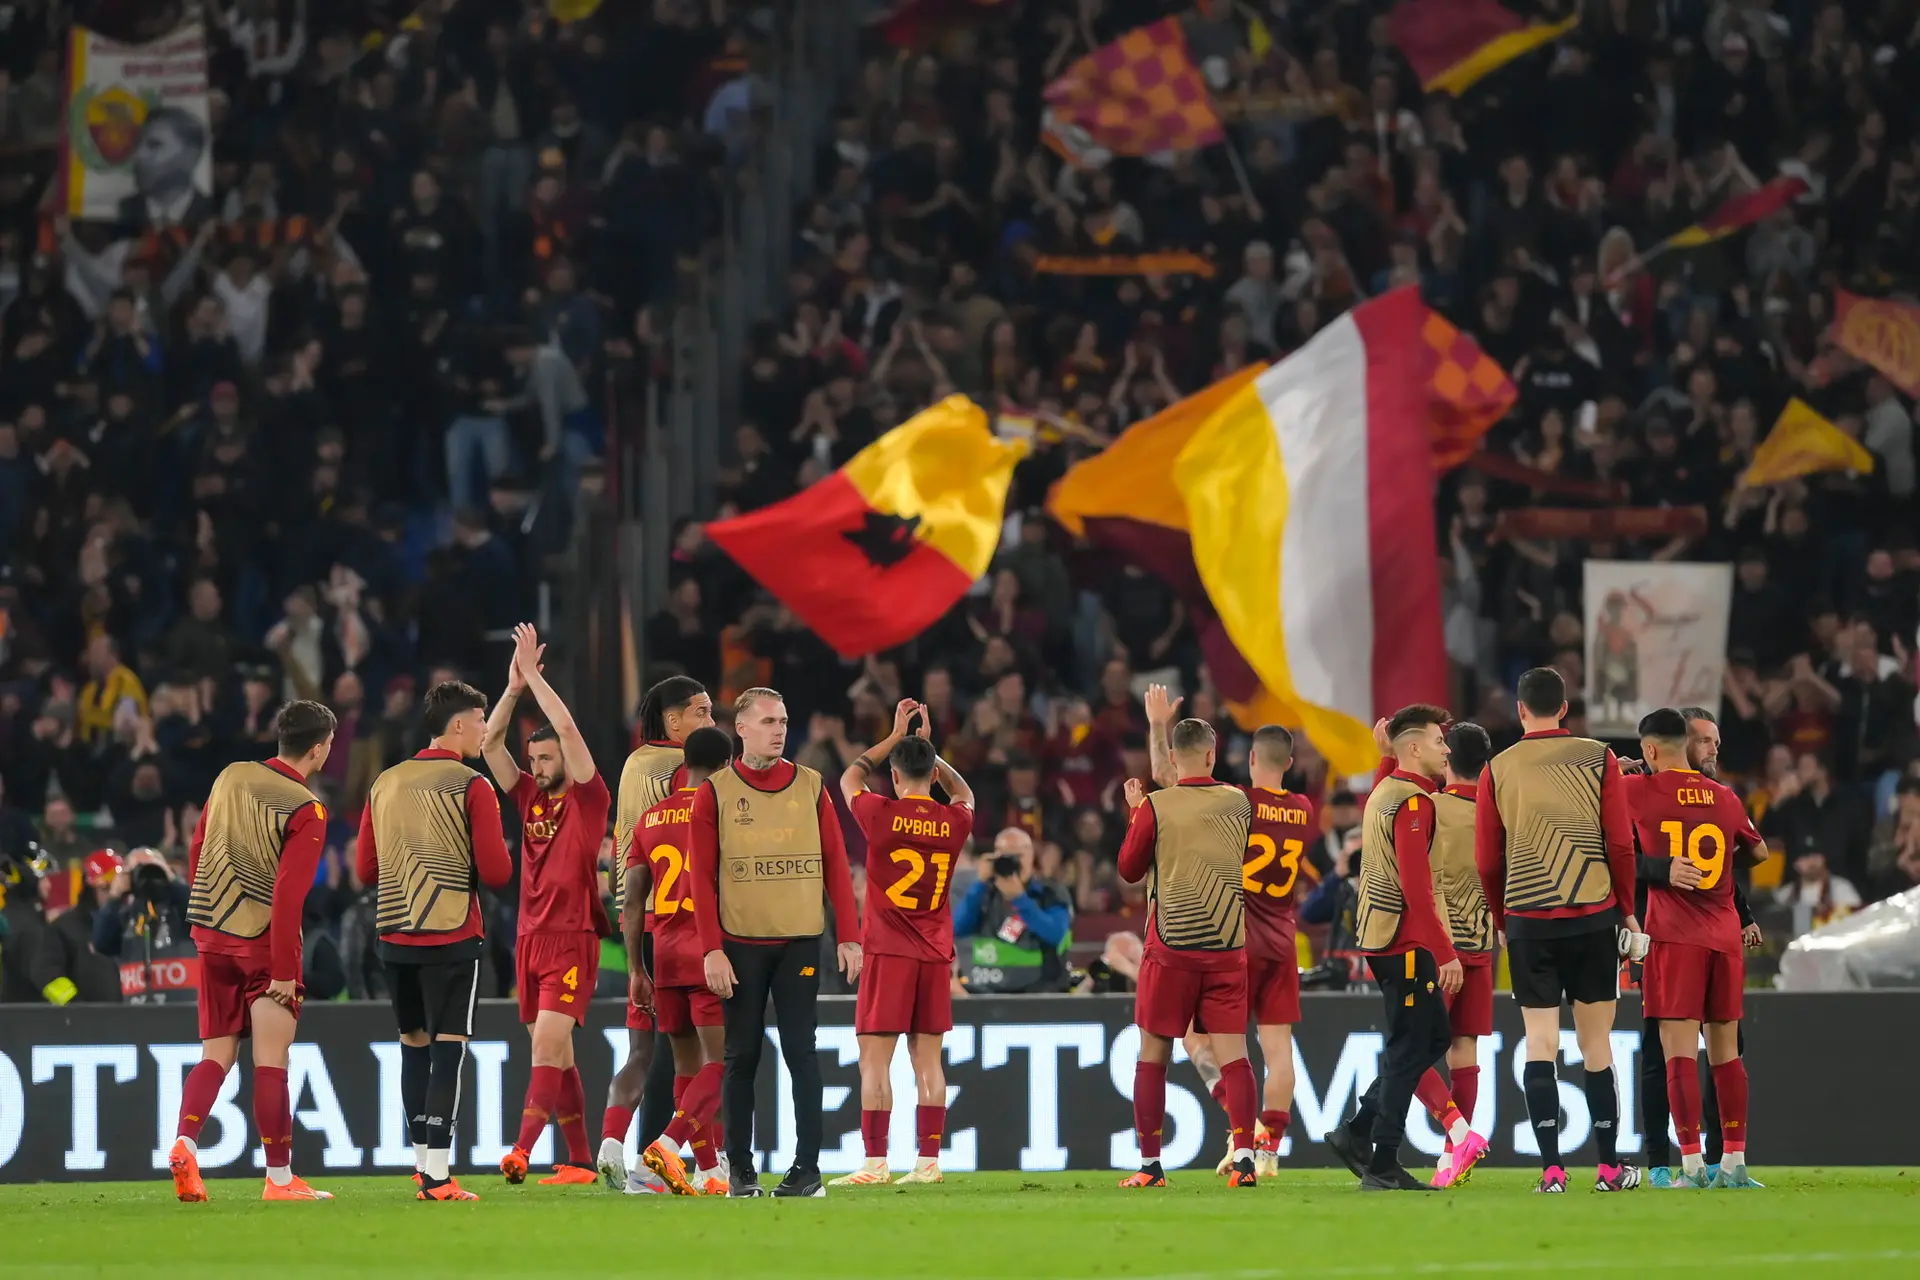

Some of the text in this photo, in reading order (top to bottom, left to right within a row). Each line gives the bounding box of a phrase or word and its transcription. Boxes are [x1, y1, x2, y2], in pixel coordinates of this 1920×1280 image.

[1677, 787, 1715, 806] ÇELIK
[645, 807, 692, 829] WIJNAL
[891, 815, 950, 838] DYBALA
[1256, 803, 1308, 826] MANCINI
[1242, 833, 1304, 898] 23
[1660, 820, 1726, 890] 19
[754, 859, 822, 876] RESPECT
[885, 848, 950, 911] 21
[562, 965, 579, 991] 4
[0, 1041, 555, 1171] TBALL
